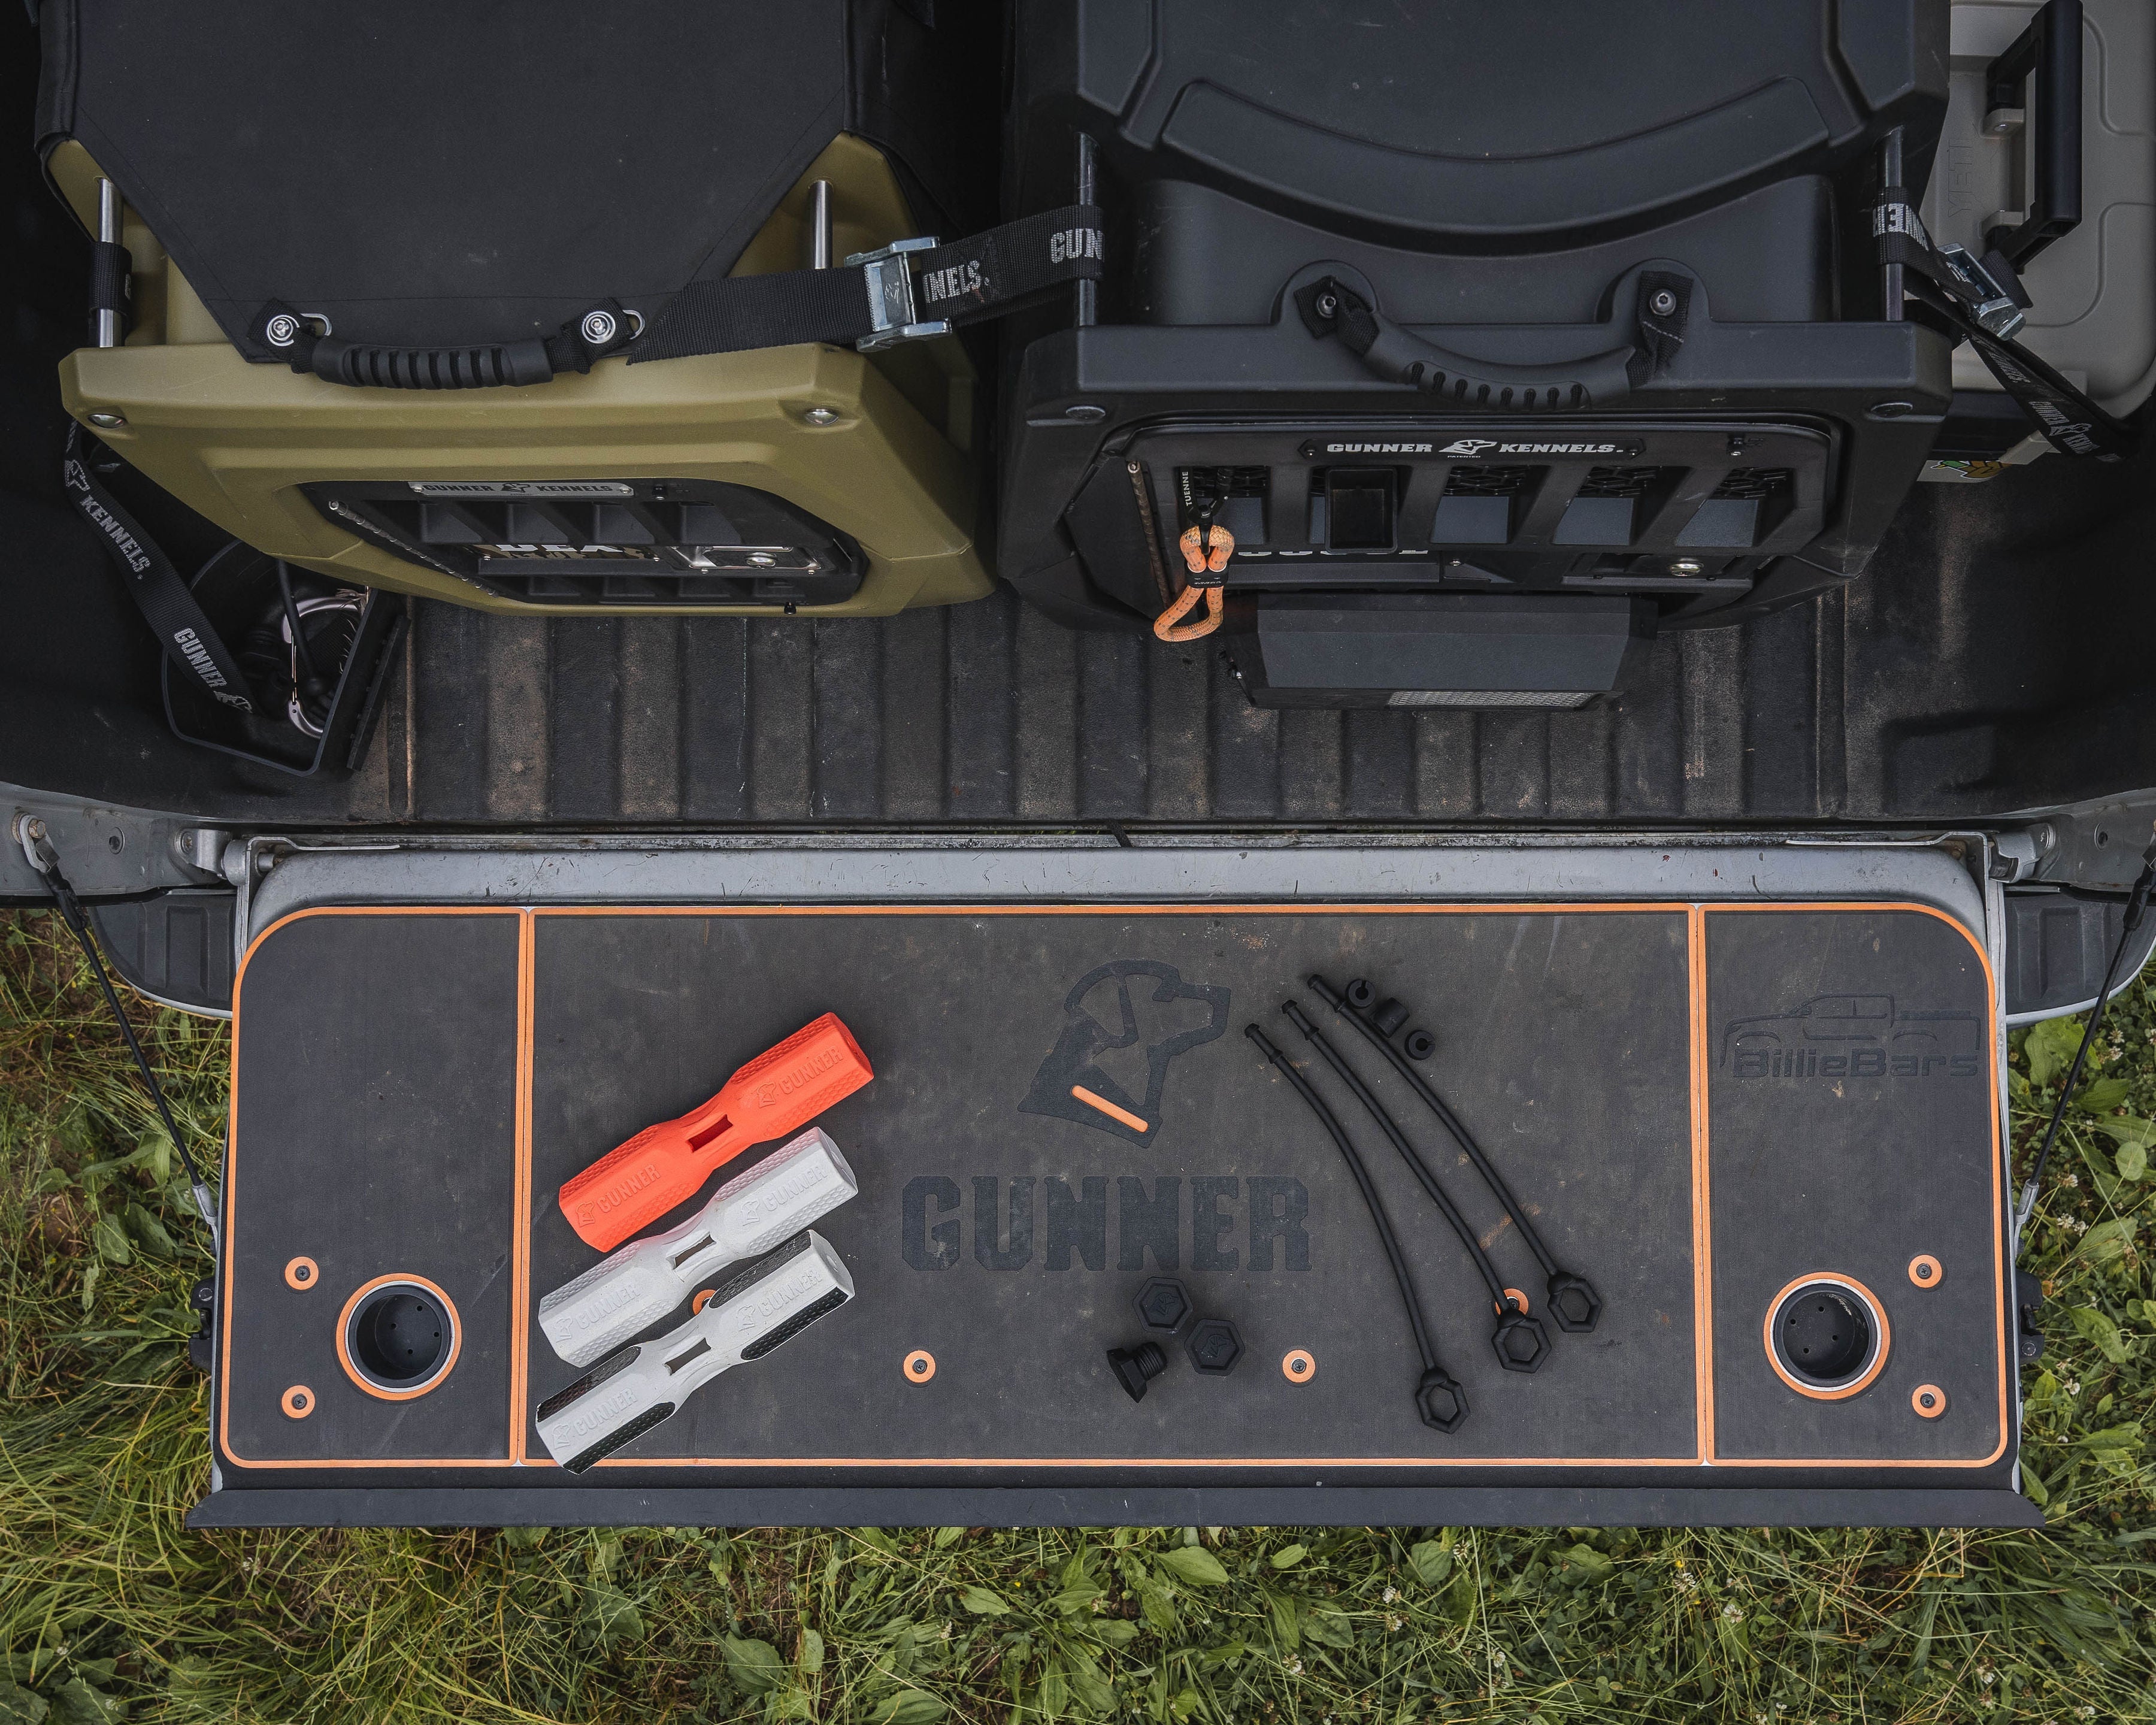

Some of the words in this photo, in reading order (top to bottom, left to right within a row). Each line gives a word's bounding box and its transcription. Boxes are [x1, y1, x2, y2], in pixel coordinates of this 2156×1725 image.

[1948, 139, 1975, 218] YETI
[1327, 443, 1433, 453] GUNNER
[1499, 443, 1616, 453] KENNELS
[79, 494, 151, 573] KENNELS
[174, 627, 227, 688] GUNNER
[779, 1046, 843, 1095] GUNNER
[1733, 1048, 1977, 1078] BillieBars
[596, 1164, 661, 1213] GUNNER
[762, 1163, 829, 1212] GUNNER
[902, 1175, 1313, 1271] GUNNER
[575, 1283, 642, 1330] GUNNER
[758, 1268, 822, 1318] GUNNER
[572, 1387, 638, 1438] GUNNER
